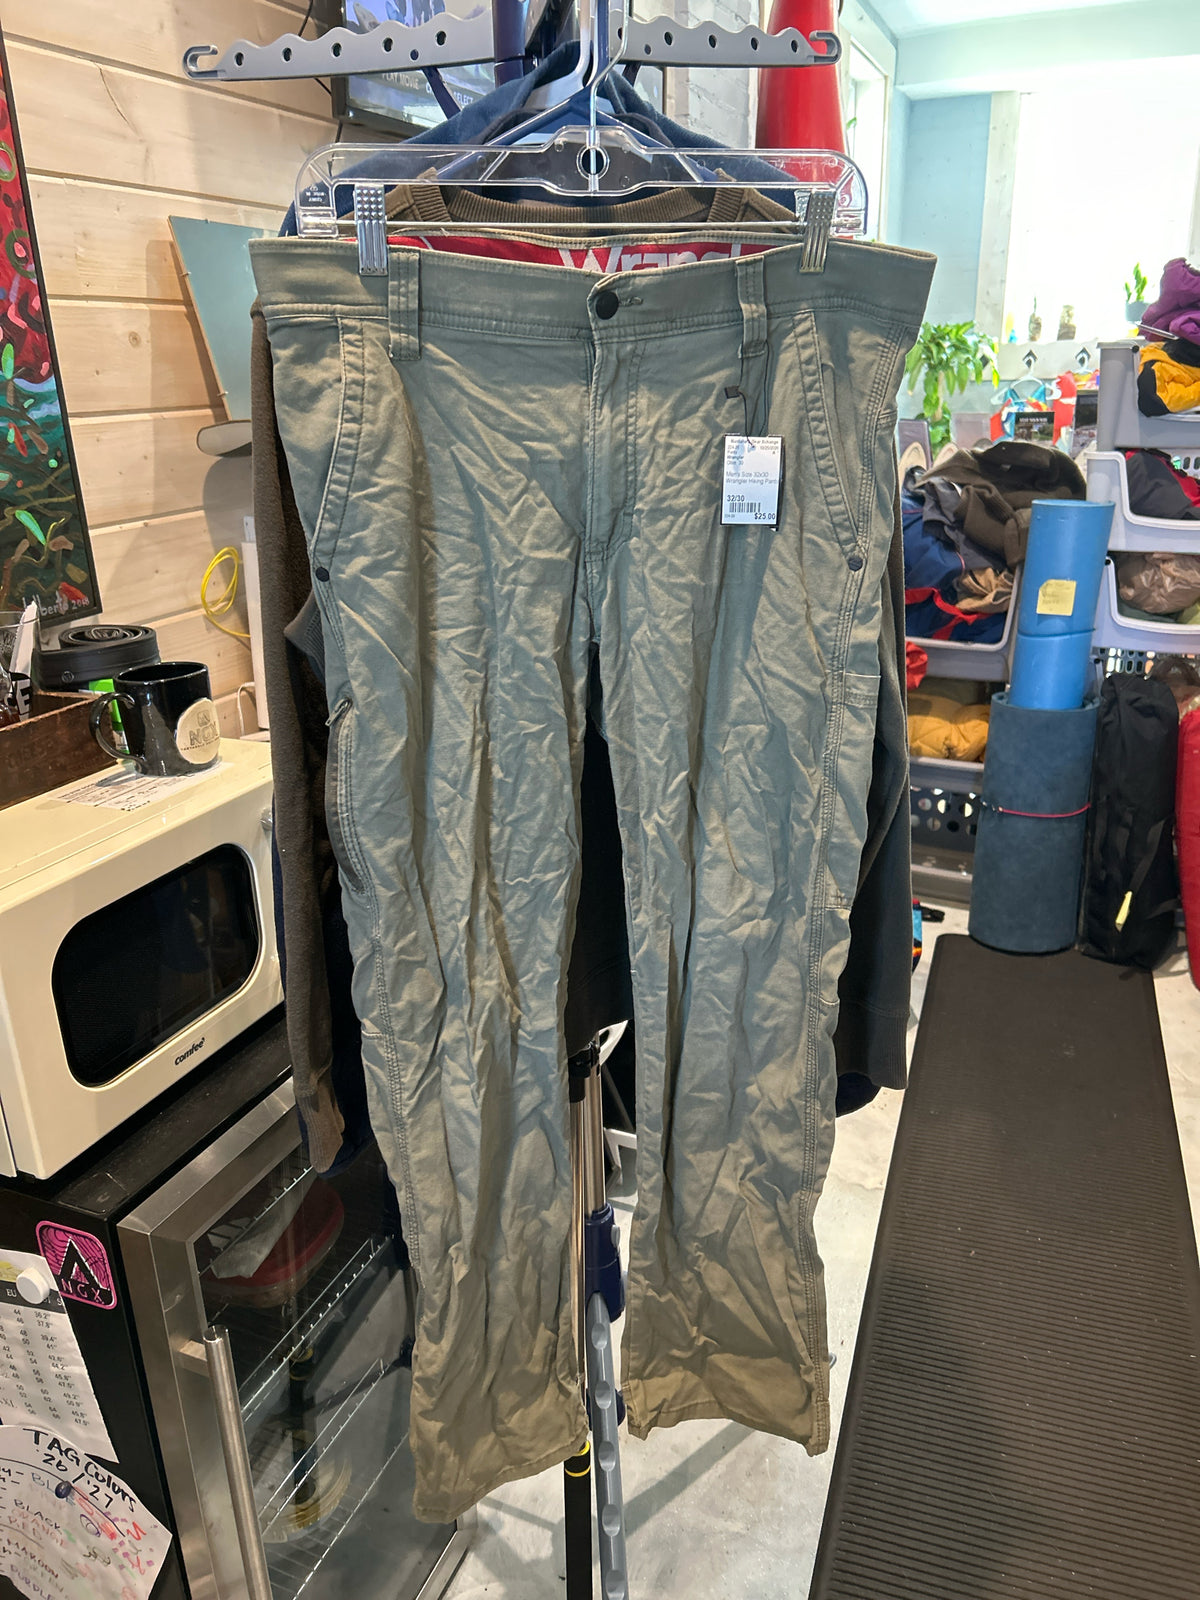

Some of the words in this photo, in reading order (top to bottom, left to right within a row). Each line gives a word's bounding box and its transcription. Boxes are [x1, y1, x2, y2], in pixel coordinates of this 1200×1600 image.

[399, 74, 419, 90] MOVIE
[453, 91, 474, 106] SELECT
[61, 1278, 105, 1305] NGX
[22, 1427, 81, 1467] TAG
[83, 1461, 137, 1513] Colors
